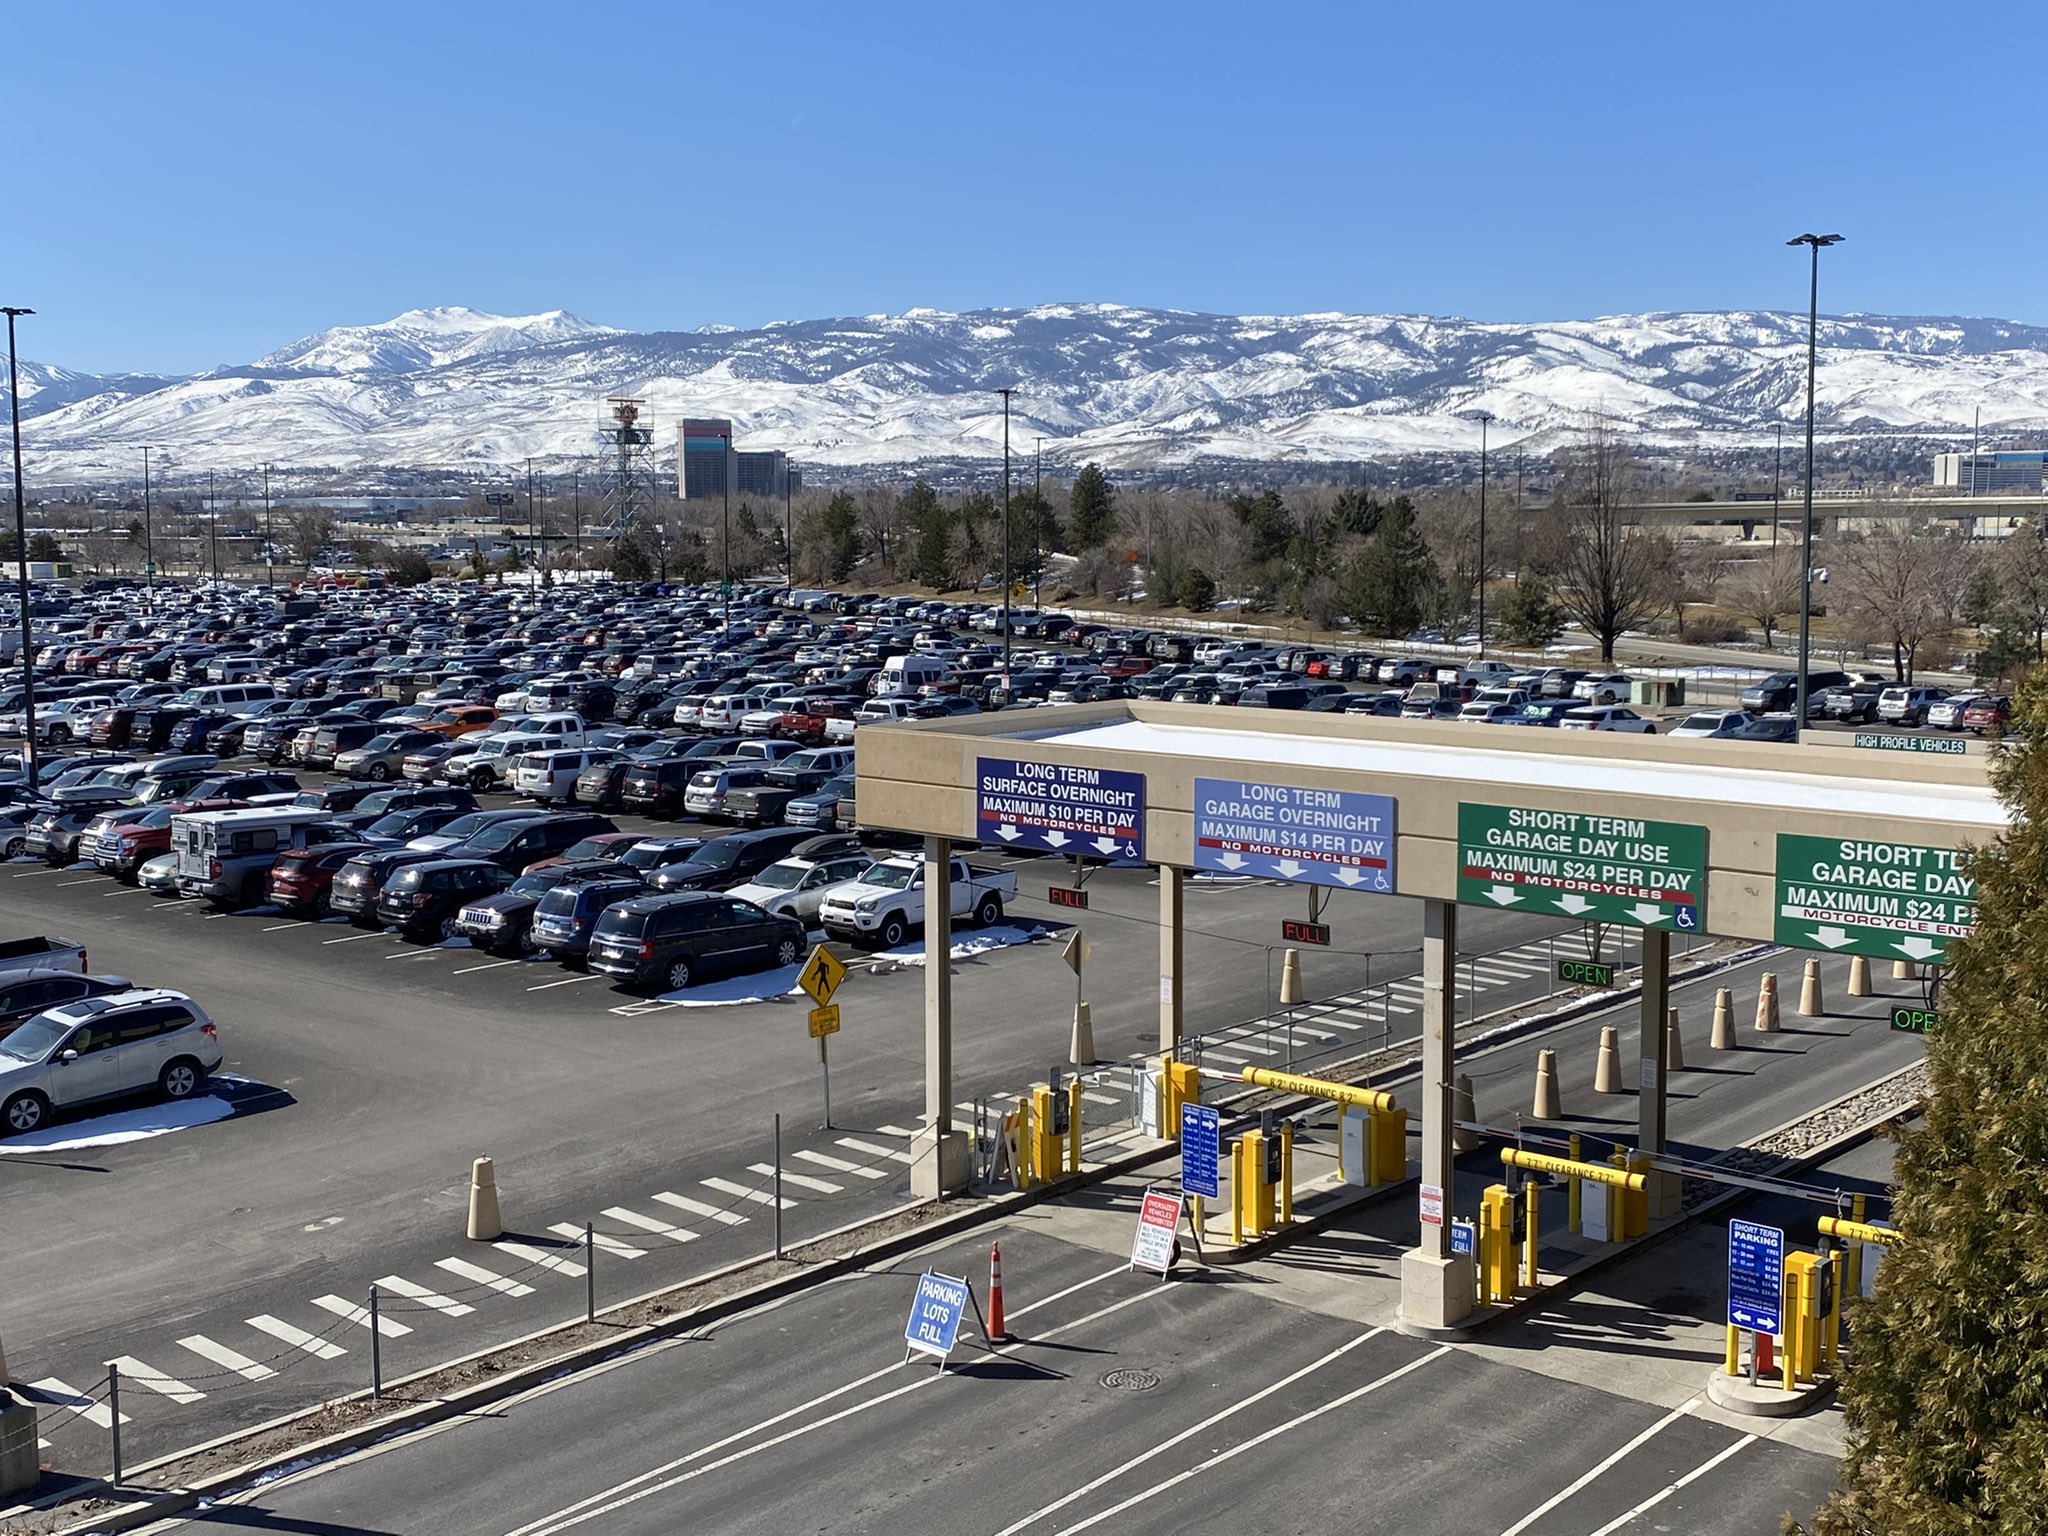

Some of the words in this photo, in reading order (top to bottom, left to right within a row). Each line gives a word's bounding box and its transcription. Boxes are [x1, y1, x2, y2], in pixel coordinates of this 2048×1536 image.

[1856, 735, 1877, 747] HIGH
[1881, 736, 1917, 750] PROFILE
[1920, 739, 1964, 753] VEHICLES
[1016, 762, 1055, 780] LONG
[1059, 767, 1099, 785] TERM
[983, 777, 1047, 797] SURFACE
[1050, 784, 1135, 807] OVERNIGHT
[1241, 784, 1288, 803] LONG
[1293, 789, 1341, 808] TERM
[983, 797, 1045, 816] MAXIMUM
[1049, 804, 1071, 819] $10
[1075, 808, 1103, 823] PER
[1107, 813, 1135, 827] DAY
[1206, 800, 1275, 821] GARAGE
[1279, 808, 1381, 832] OVERNIGHT
[1509, 809, 1579, 832] SHORT
[1585, 816, 1645, 838] TERM
[1000, 814, 1016, 822] NO
[1023, 817, 1116, 835] MOTORCYCLES
[1202, 822, 1276, 843] MAXIMUM
[1280, 830, 1307, 847] $14
[1312, 834, 1345, 851] PER
[1351, 839, 1384, 856] DAY
[1487, 828, 1572, 852] GARAGE
[1579, 838, 1620, 858] DAY
[1625, 843, 1669, 863] USE
[1222, 841, 1242, 850] NO
[1250, 845, 1361, 865] MOTORCYCLES
[1840, 841, 1927, 867] SHORT
[1933, 850, 1974, 871] TE
[1467, 850, 1557, 876] MAXIMUM
[1563, 860, 1597, 880] $24
[1603, 866, 1643, 886] PER
[1651, 873, 1691, 891] DAY
[1812, 862, 1917, 891] GARAGE
[1925, 874, 1975, 897] DAY
[1491, 871, 1515, 882] NO
[1525, 875, 1662, 900] MOTORCYCLES
[1052, 889, 1083, 907] FULL
[1788, 887, 1898, 916] MAXIMUM
[1905, 899, 1946, 921] $24
[1286, 923, 1323, 943] FULL
[1804, 909, 1928, 931] MOTORCYCLE
[1936, 924, 1974, 937] ENT
[1562, 963, 1606, 985] OPEN
[1289, 1081, 1336, 1098] CLEARANCE
[1545, 1161, 1594, 1180] CLEARANCE
[1734, 1222, 1758, 1235] SHORT
[1759, 1228, 1779, 1239] TERM
[1734, 1230, 1779, 1248] PARKING
[1454, 1240, 1470, 1252] FULL
[921, 1280, 962, 1307] PARKING
[923, 1302, 950, 1324] LOTS
[919, 1322, 941, 1344] FULL
